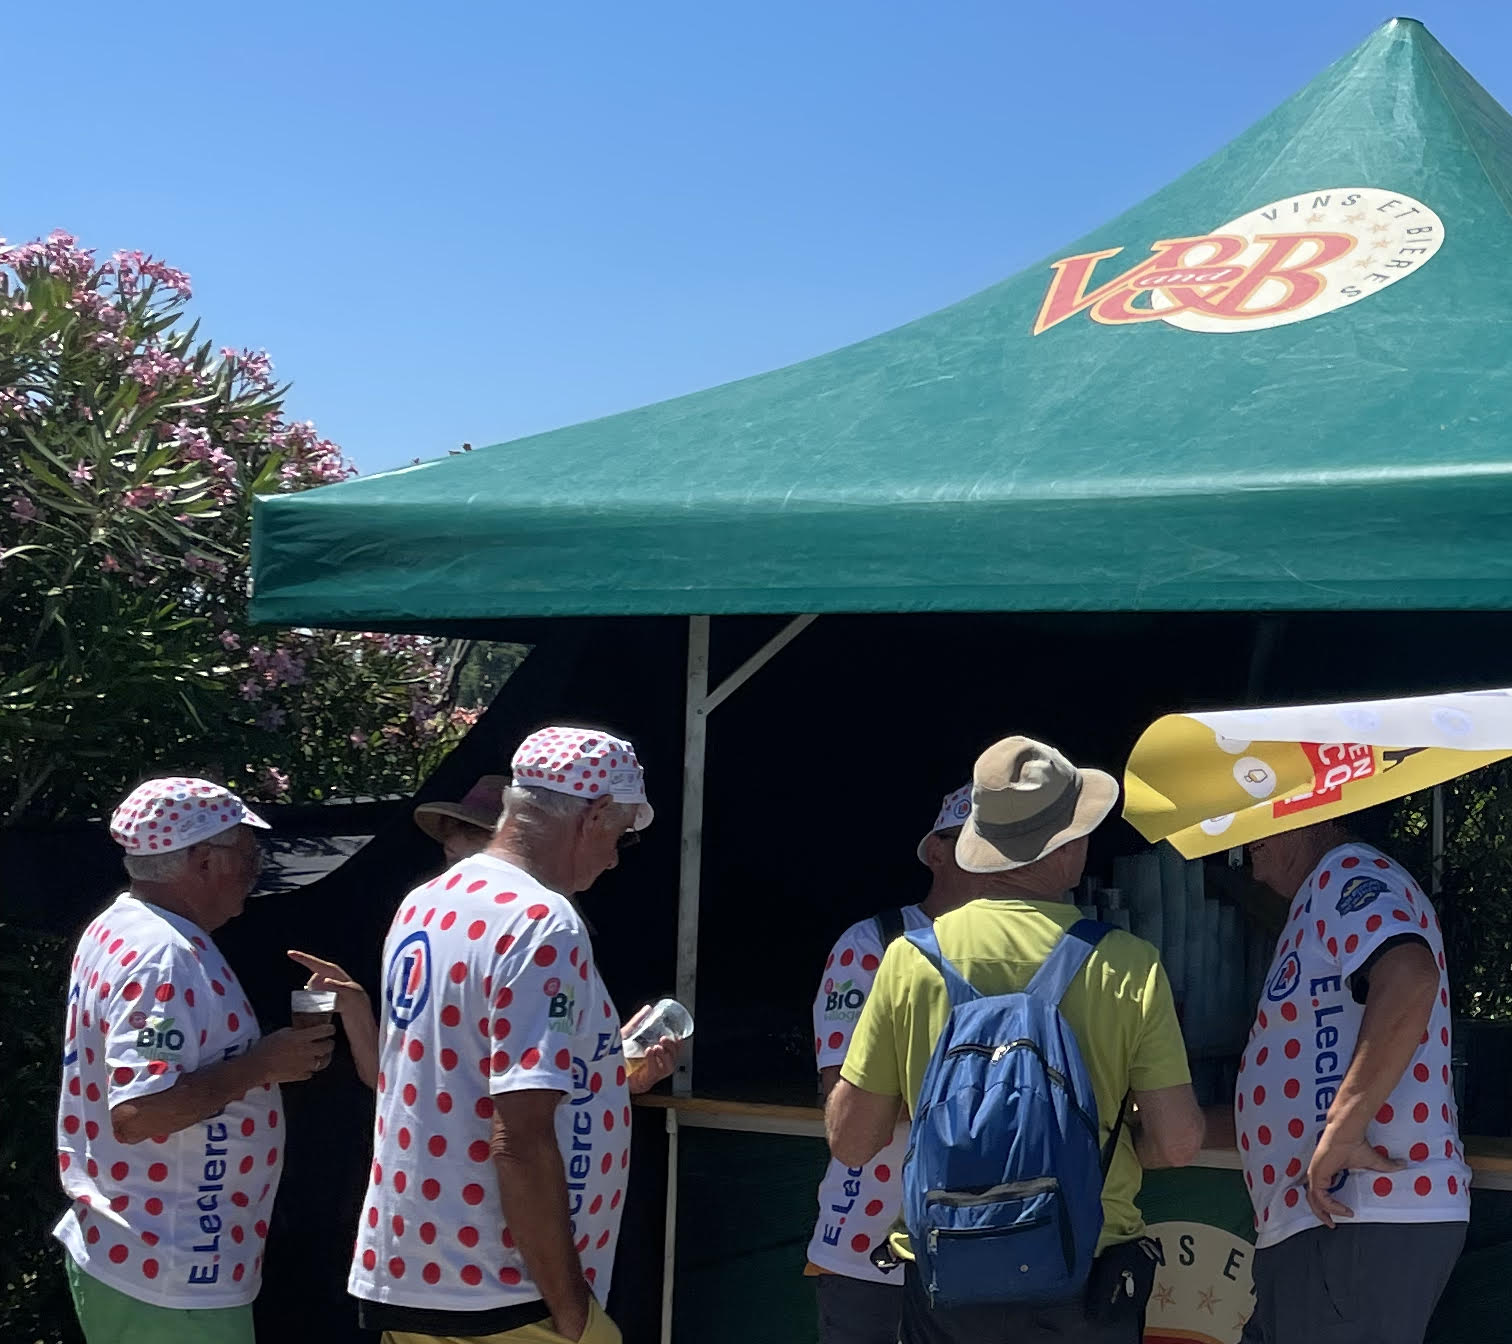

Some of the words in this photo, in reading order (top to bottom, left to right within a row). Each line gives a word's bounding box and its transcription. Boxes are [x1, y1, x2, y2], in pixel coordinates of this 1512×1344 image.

[1261, 193, 1362, 222] VINS
[1376, 198, 1421, 220] ET
[1340, 225, 1434, 298] BIERES
[1033, 232, 1358, 336] V&B
[1142, 267, 1230, 288] and
